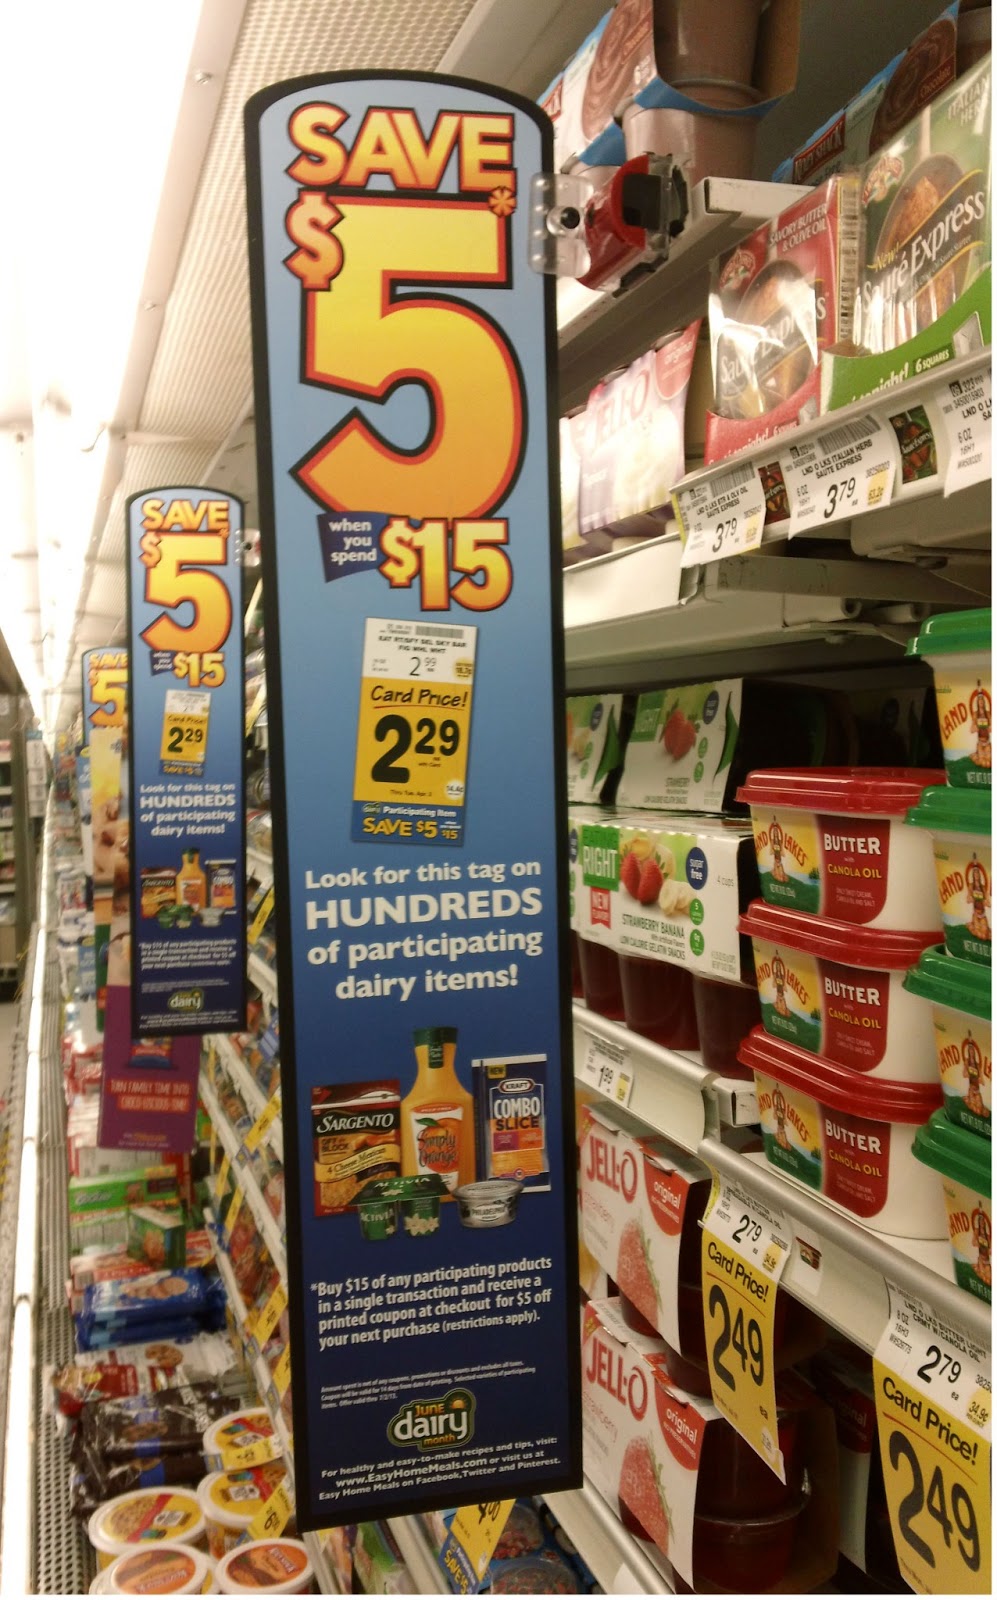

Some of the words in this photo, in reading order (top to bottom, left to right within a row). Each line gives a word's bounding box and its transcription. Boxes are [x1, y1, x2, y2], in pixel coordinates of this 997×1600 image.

[285, 101, 517, 192] SAVE
[769, 223, 798, 247] SAVORY
[798, 202, 828, 229] BUTTER
[782, 241, 789, 253] &
[789, 226, 812, 249] OLIVE
[811, 218, 827, 235] OIL
[911, 191, 984, 278] Express
[915, 358, 922, 373] 6
[922, 349, 950, 370] SQUARES
[962, 406, 977, 419] LND
[978, 402, 984, 412] O
[963, 428, 973, 441] OZ
[801, 466, 814, 476] LND
[820, 458, 832, 468] LKS
[831, 448, 855, 463] ITALIAN
[856, 439, 873, 452] HERB
[816, 466, 835, 479] SAUTE
[835, 453, 863, 471] EXPRESS
[140, 498, 230, 531] SAVE
[328, 517, 372, 533] when
[330, 548, 377, 566] spend
[343, 536, 372, 550] you
[378, 514, 514, 612] $15
[173, 651, 226, 688] $15
[370, 685, 414, 703] Card
[418, 688, 468, 708] Price!
[940, 703, 968, 741] LAND
[140, 783, 165, 793] Look
[167, 783, 182, 792] for
[184, 783, 203, 792] this
[205, 783, 221, 793] tag
[222, 783, 235, 791] on
[140, 793, 236, 809] HUNDREDS
[140, 811, 154, 822] of
[156, 810, 235, 824] participating
[383, 806, 436, 817] Participating
[437, 809, 457, 817] Item
[150, 825, 184, 838] dairy
[186, 824, 225, 835] items!
[362, 817, 413, 836] SAVE
[416, 819, 438, 838] $5
[784, 832, 808, 867] LAKES
[824, 833, 882, 856] BUTTER
[305, 868, 368, 890] Look
[373, 866, 411, 884] for
[416, 862, 461, 883] this
[467, 862, 506, 883] tag
[511, 861, 541, 877] on
[582, 846, 618, 879] RIGHT
[689, 858, 704, 869] sugar
[690, 869, 703, 881] free
[827, 863, 861, 878] CANOLA
[862, 867, 882, 879] OIL
[306, 887, 543, 930] HUNDREDS
[621, 914, 660, 933] STRAWBERRY
[660, 921, 685, 939] BANANA
[307, 939, 342, 965] of
[347, 928, 543, 970] participating
[335, 973, 417, 1002] dairy
[424, 963, 518, 993] items!
[786, 969, 810, 1006] LAKES
[824, 977, 881, 1006] BUTTER
[169, 995, 201, 1009] dairy
[828, 1007, 861, 1026] CANOLA
[861, 1016, 882, 1030] OIL
[505, 1080, 530, 1091] KRAFT
[316, 1112, 395, 1134] SARGENTO
[493, 1097, 541, 1120] COMBO
[495, 1116, 540, 1131] SLICE
[786, 1103, 811, 1143] LAKES
[825, 1118, 882, 1155] BUTTER
[586, 1134, 638, 1204] JELL-O
[829, 1149, 861, 1172] CANOLA
[862, 1164, 883, 1178] OIL
[653, 1180, 681, 1210] original
[345, 1277, 369, 1294] $15
[371, 1274, 387, 1289] of
[387, 1274, 412, 1292] any
[413, 1263, 496, 1288] participating
[498, 1256, 553, 1276] products
[707, 1241, 735, 1276] Card
[734, 1262, 769, 1303] Price!
[318, 1299, 332, 1314] in
[334, 1301, 342, 1312] a
[344, 1292, 384, 1313] single
[386, 1284, 459, 1306] transaction
[460, 1279, 486, 1295] and
[487, 1276, 532, 1293] receive
[533, 1276, 542, 1288] a
[318, 1310, 367, 1335] printed
[369, 1307, 417, 1327] coupon
[418, 1304, 433, 1318] at
[434, 1296, 491, 1317] checkout
[495, 1293, 514, 1309] for
[516, 1291, 532, 1307] $5
[533, 1288, 553, 1304] off
[901, 1314, 910, 1326] OZ
[318, 1334, 349, 1352] your
[351, 1325, 381, 1345] next
[383, 1320, 441, 1343] purchase
[441, 1313, 504, 1334] (restrictions
[505, 1309, 541, 1326] apply).
[904, 1301, 917, 1313] LND
[938, 1319, 966, 1343] BUTTER
[966, 1336, 987, 1359] LIGHT
[912, 1313, 932, 1331] CRMY
[932, 1325, 968, 1354] W/CANOLA
[969, 1348, 981, 1364] OIL
[586, 1336, 648, 1422] JELL-O
[951, 1391, 960, 1401] ea
[393, 1410, 468, 1441] dairy
[666, 1408, 698, 1445] original
[882, 1377, 922, 1422] Card
[925, 1408, 979, 1466] Price!
[423, 1433, 456, 1446] month
[321, 1469, 338, 1479] For
[339, 1461, 375, 1476] healthy
[377, 1459, 395, 1470] and
[396, 1449, 461, 1467] easy-to-make
[461, 1445, 495, 1458] recipes
[495, 1442, 513, 1453] and
[514, 1440, 534, 1451] tips,
[535, 1436, 558, 1447] visit:
[335, 1457, 488, 1488] www.EasyHomeMeals.com
[489, 1456, 500, 1464] or
[501, 1452, 522, 1463] visit
[522, 1451, 534, 1460] us
[534, 1449, 545, 1458] at
[318, 1490, 341, 1501] Easy
[342, 1485, 371, 1497] Home
[373, 1481, 400, 1492] Meals
[402, 1479, 414, 1488] on
[498, 1462, 516, 1473] and
[517, 1457, 561, 1471] Pinterest.
